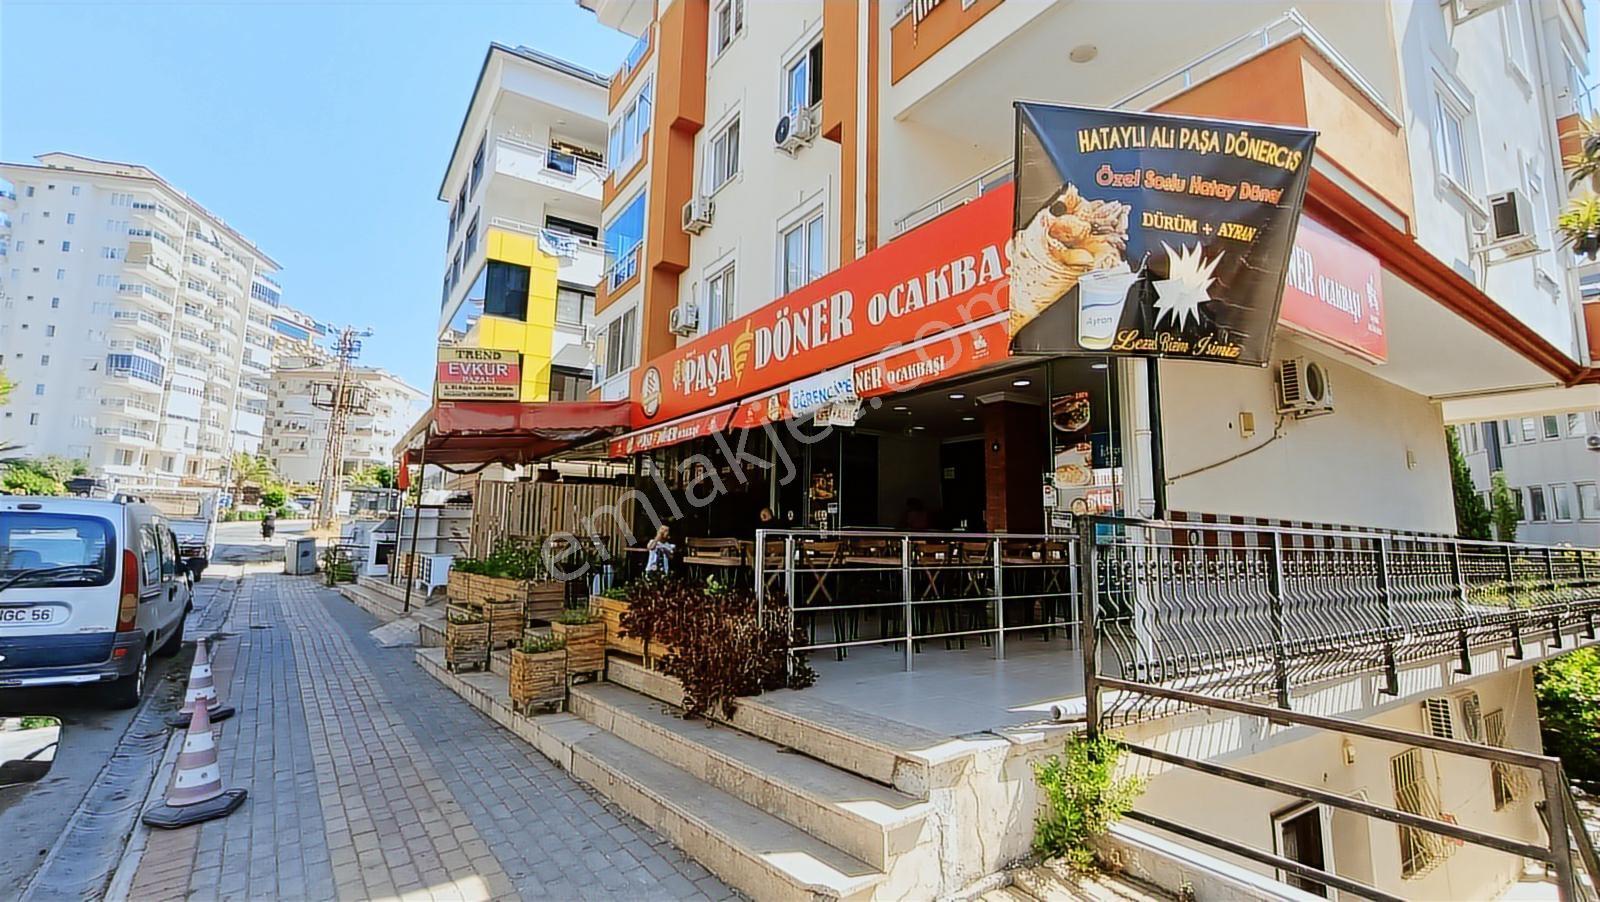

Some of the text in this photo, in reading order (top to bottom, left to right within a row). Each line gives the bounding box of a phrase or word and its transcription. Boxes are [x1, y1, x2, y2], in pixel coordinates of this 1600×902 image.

[1078, 126, 1146, 153] HATAYLI
[1179, 127, 1221, 155] PAŞA
[1095, 165, 1141, 187] Özel
[1144, 169, 1186, 193] Soslu
[1189, 175, 1237, 202] Hatay
[1142, 211, 1199, 234] DÜRÜM
[1217, 221, 1257, 243] AYRAN
[456, 350, 502, 360] TREND
[683, 344, 732, 396] PAŞA
[754, 290, 854, 370] DÖNER
[448, 362, 509, 376] EVKUR
[886, 355, 946, 384] OCAKBAŞI
[0, 609, 50, 621] GC 56
